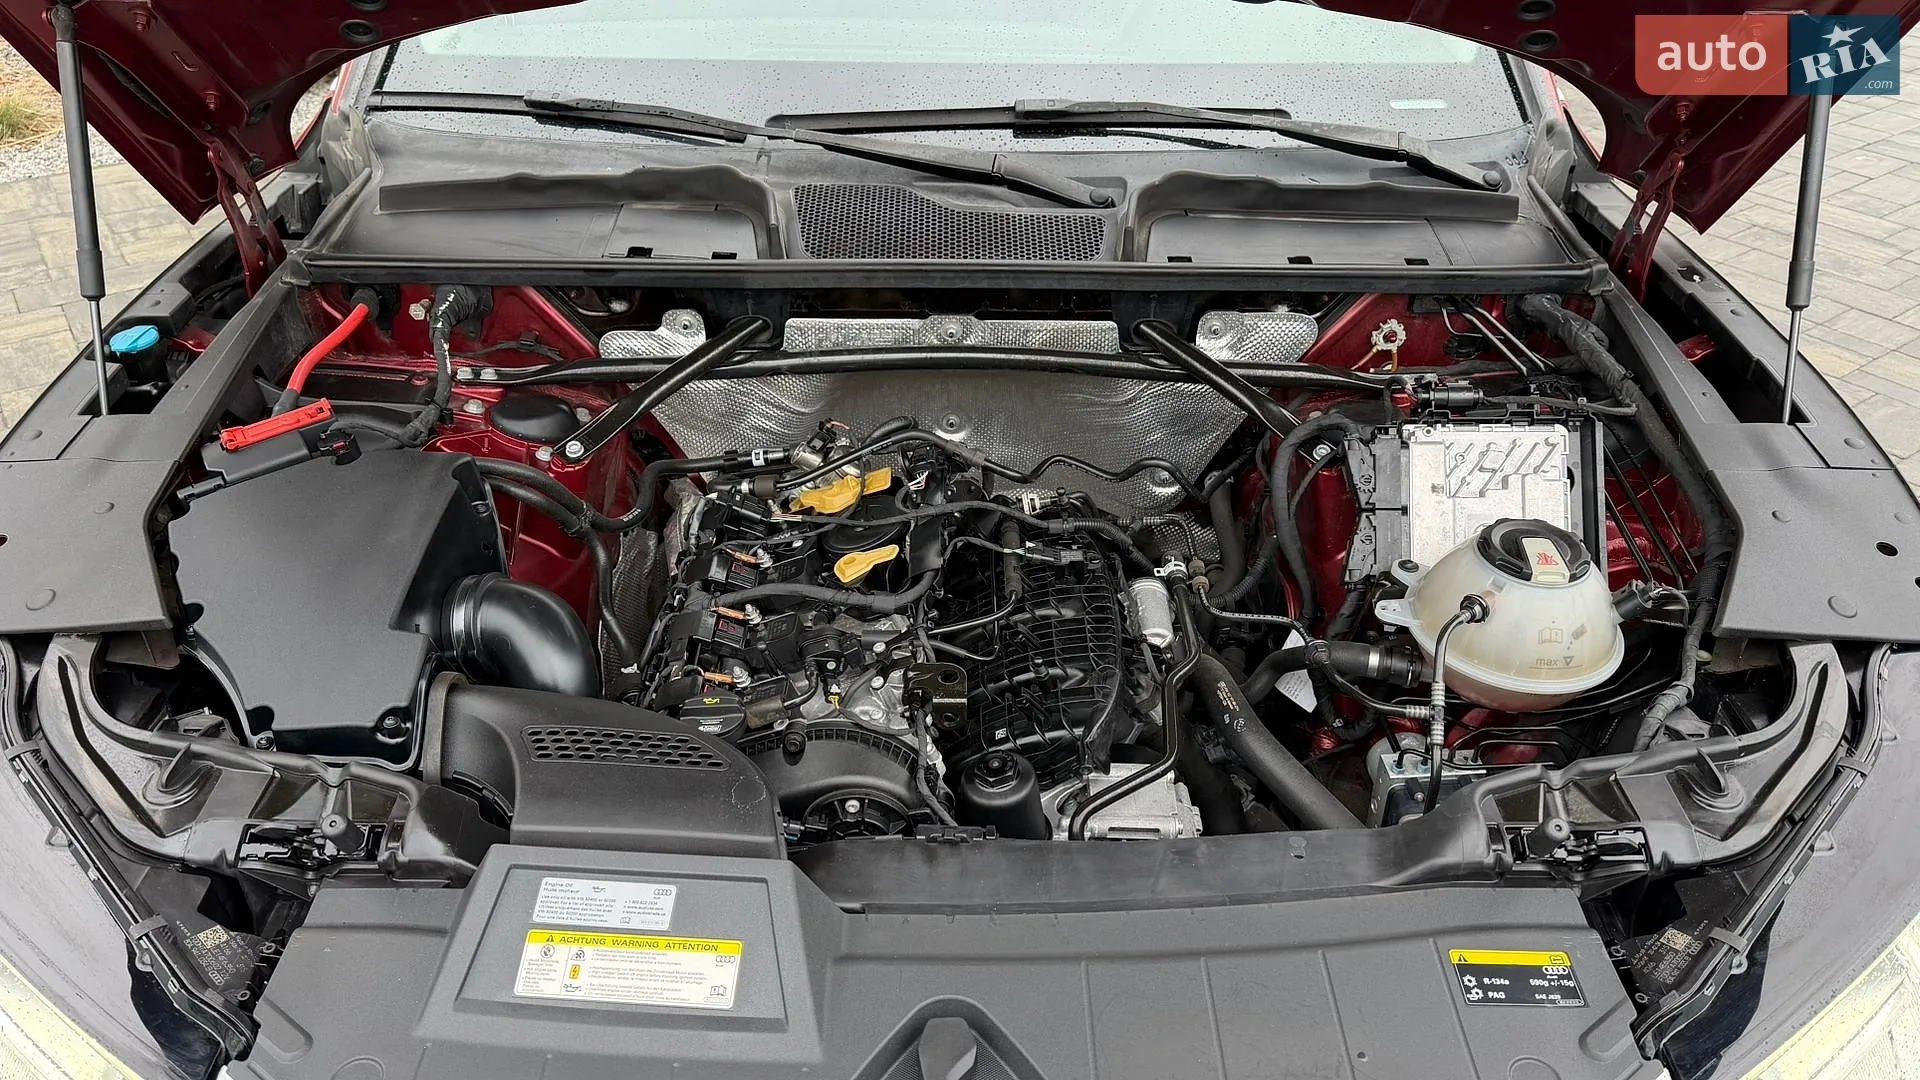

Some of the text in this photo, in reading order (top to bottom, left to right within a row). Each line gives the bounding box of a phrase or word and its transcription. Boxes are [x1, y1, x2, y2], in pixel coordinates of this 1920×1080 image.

[1535, 658, 1559, 667] max
[559, 936, 607, 946] ACHTUNG
[612, 939, 660, 949] WARNING
[664, 942, 720, 953] ATTENTION
[1483, 977, 1510, 985] R-134a
[1550, 980, 1575, 988] +/-15g
[1487, 991, 1506, 999] PAG
